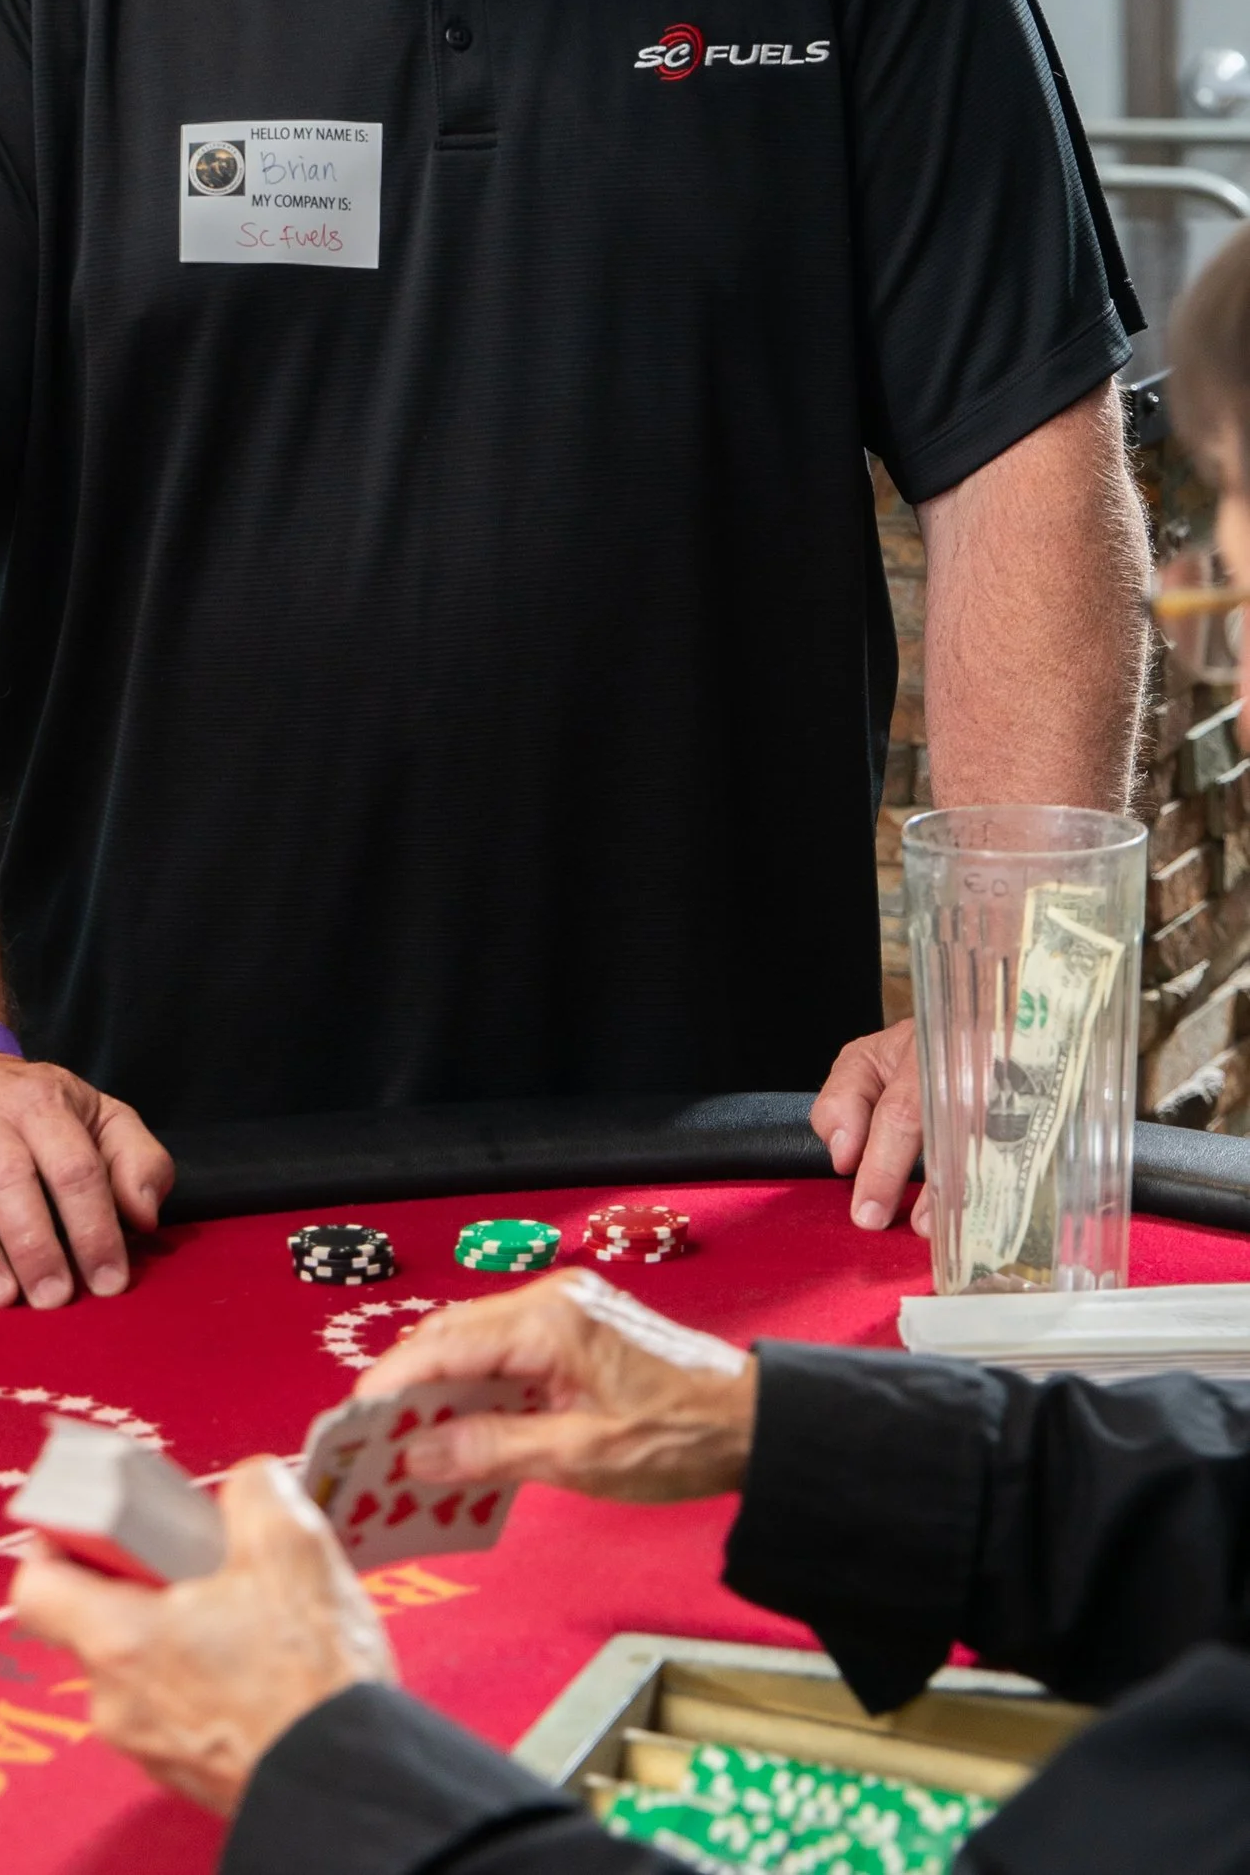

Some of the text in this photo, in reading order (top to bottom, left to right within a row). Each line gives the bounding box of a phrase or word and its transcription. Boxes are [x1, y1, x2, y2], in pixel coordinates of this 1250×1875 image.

[634, 41, 830, 68] SC FUELS
[250, 127, 369, 143] HELLO MY NAME IS:
[260, 151, 337, 185] Brian
[251, 194, 352, 211] MY COMPANY IS:
